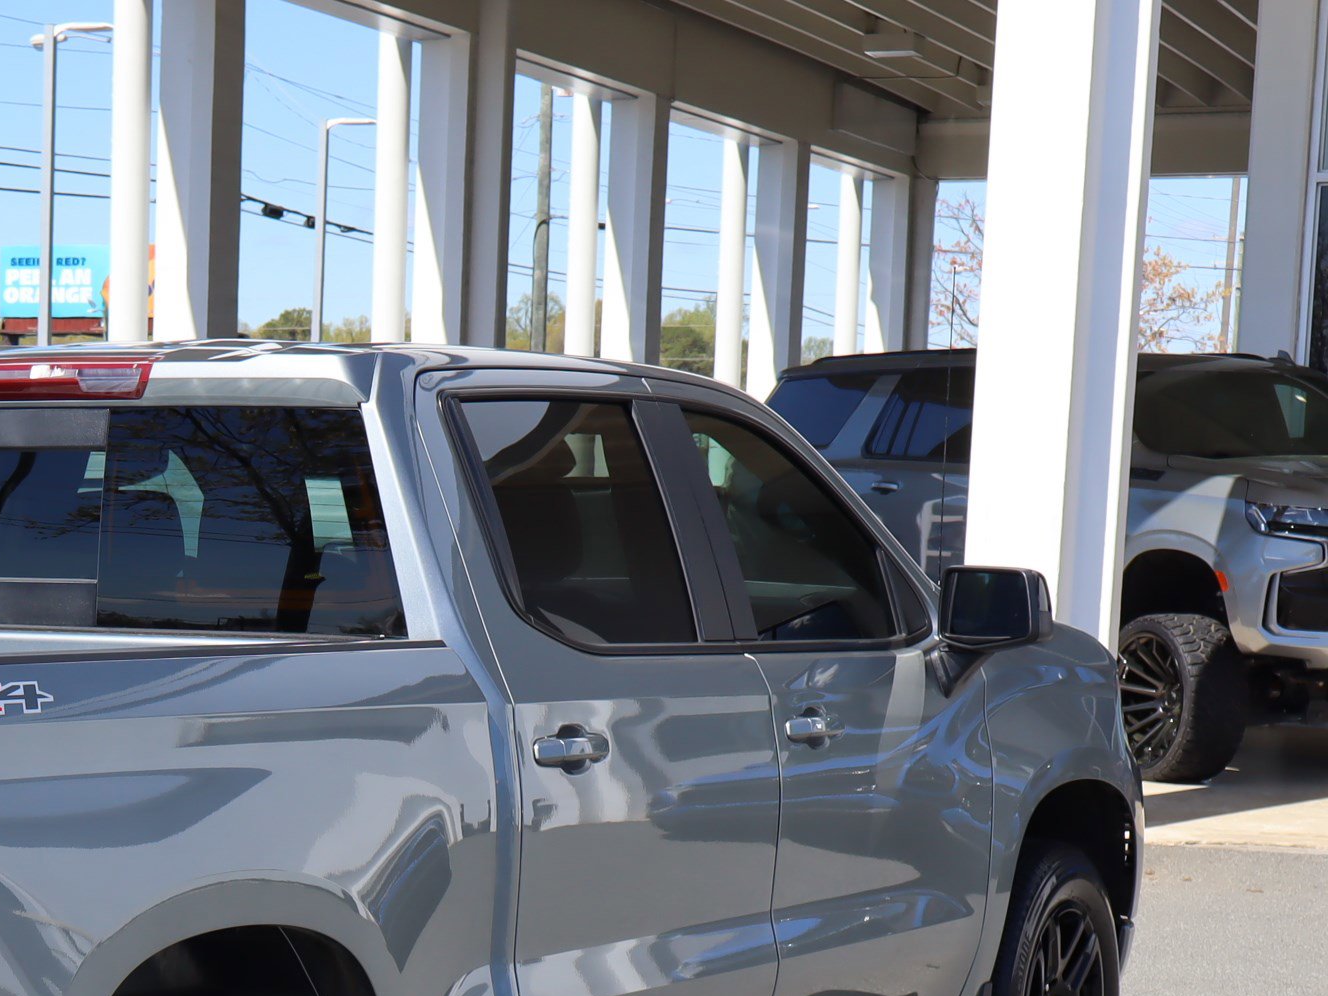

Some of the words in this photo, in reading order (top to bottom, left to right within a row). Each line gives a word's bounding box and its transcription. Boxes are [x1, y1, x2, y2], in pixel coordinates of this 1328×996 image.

[10, 257, 41, 267] SEEI
[55, 257, 87, 267] RED?
[5, 268, 57, 286] PE
[60, 268, 92, 286] AN
